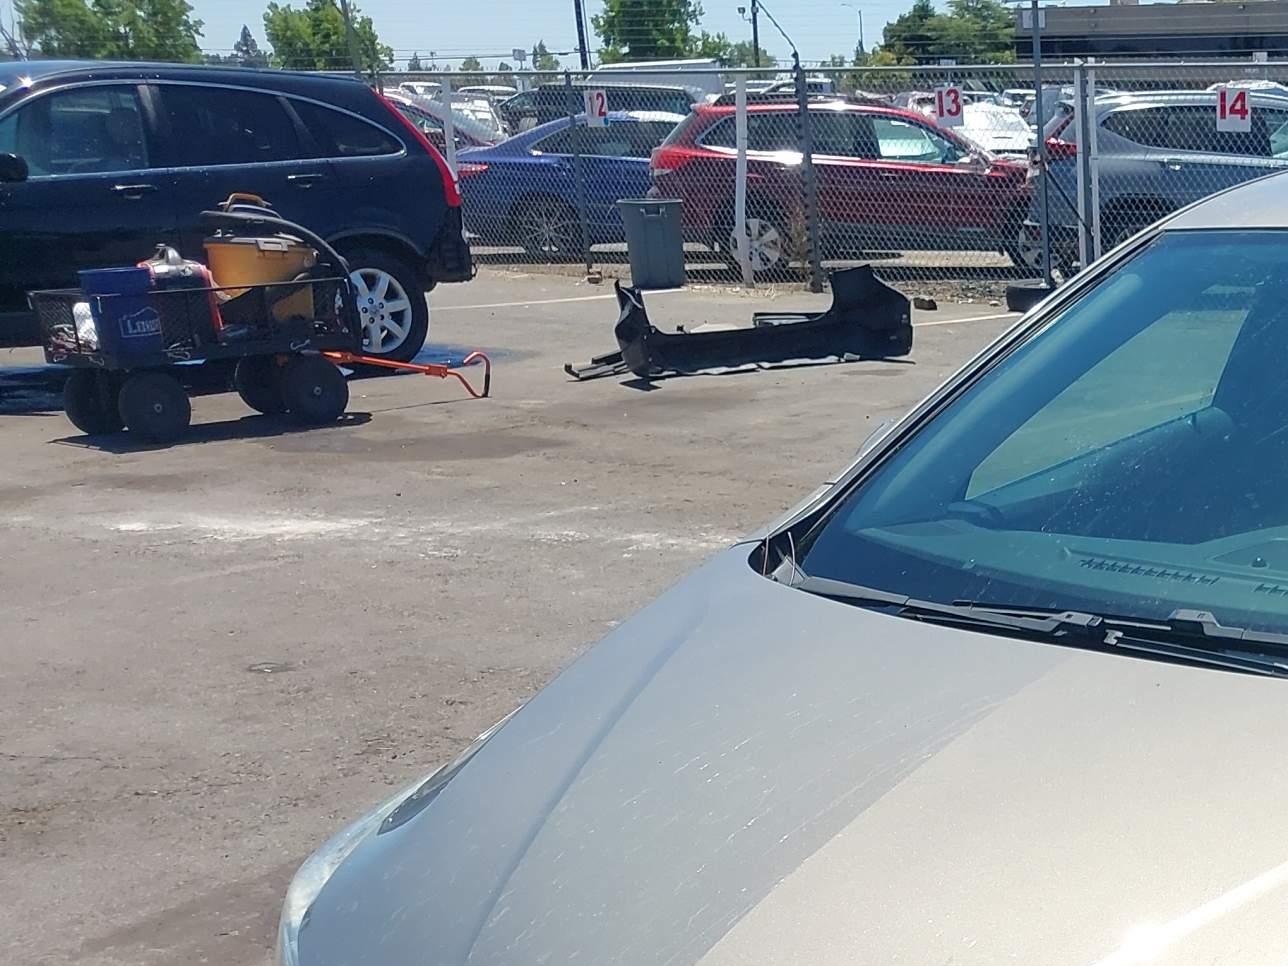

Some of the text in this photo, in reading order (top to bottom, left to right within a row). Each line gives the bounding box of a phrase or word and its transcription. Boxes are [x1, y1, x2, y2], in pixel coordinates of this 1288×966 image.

[588, 92, 607, 117] 12
[937, 88, 961, 118] 13
[1220, 91, 1249, 120] 14
